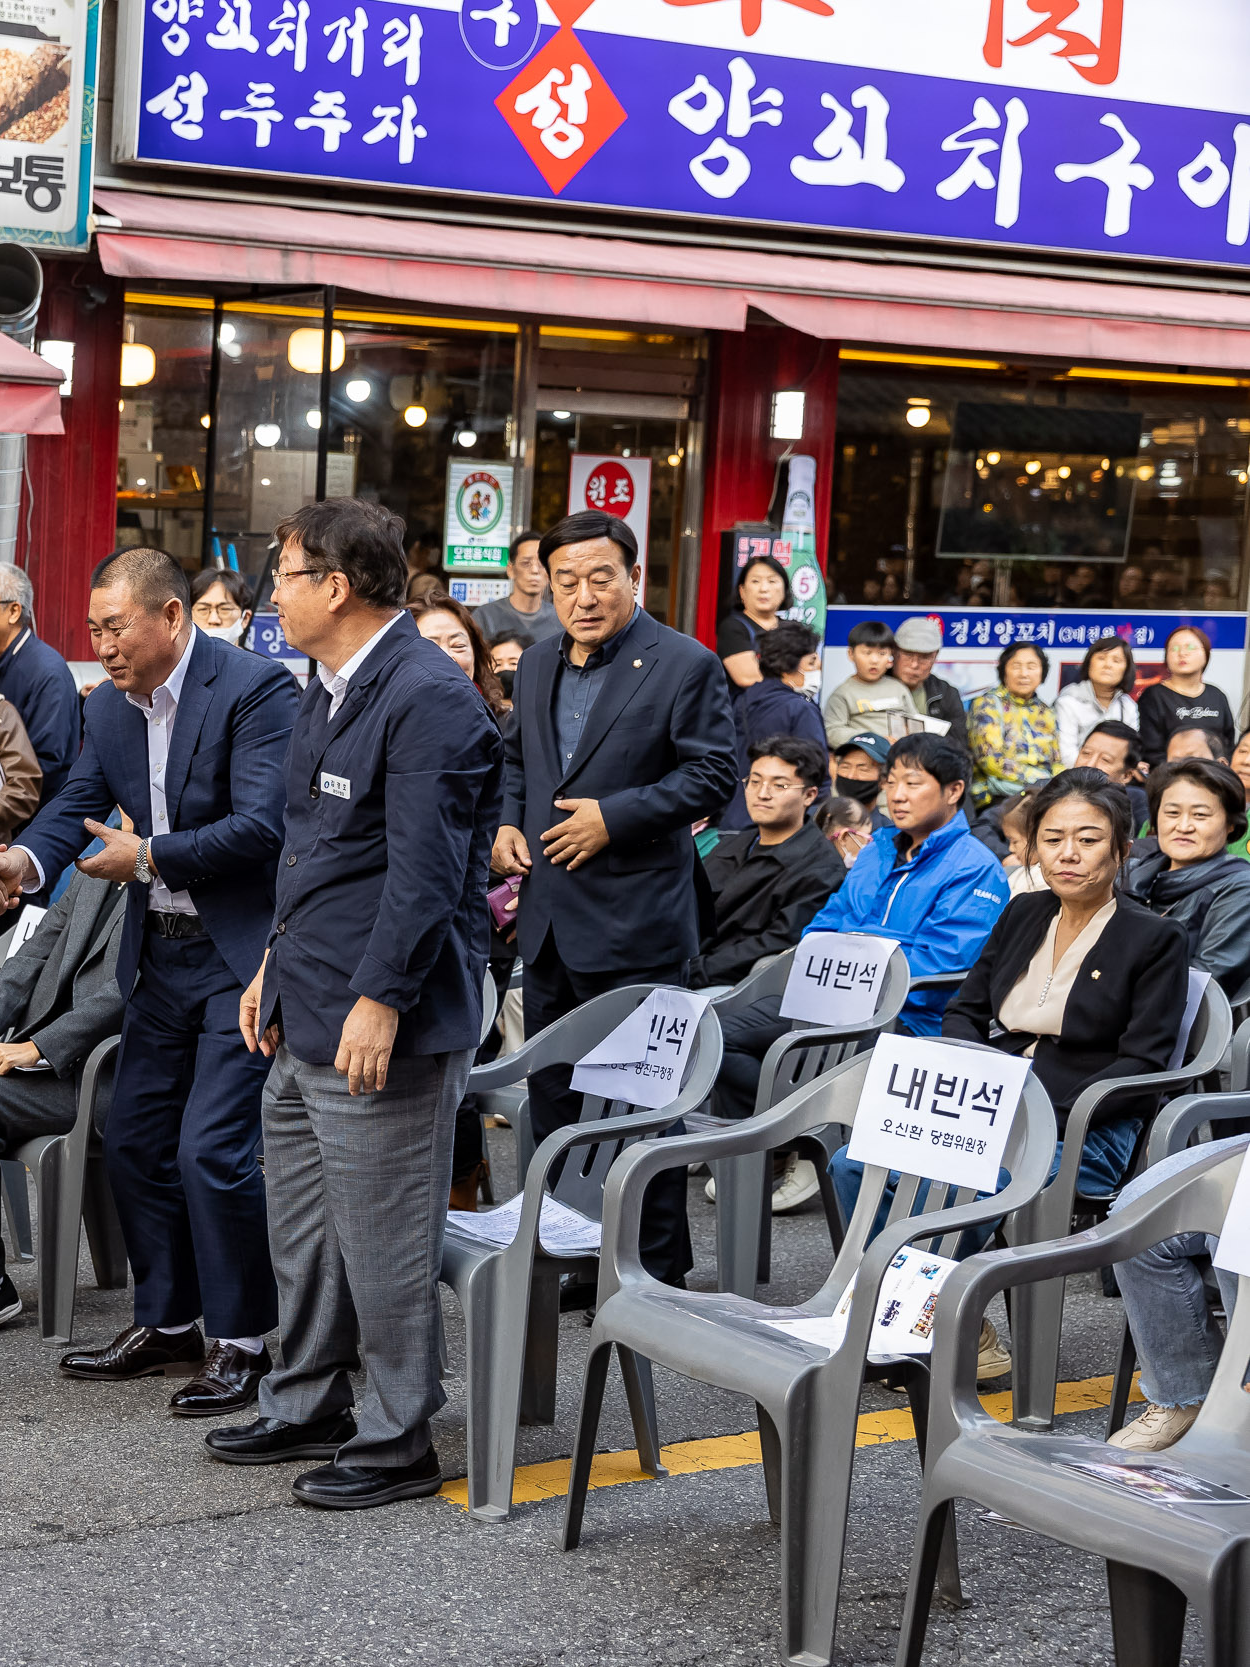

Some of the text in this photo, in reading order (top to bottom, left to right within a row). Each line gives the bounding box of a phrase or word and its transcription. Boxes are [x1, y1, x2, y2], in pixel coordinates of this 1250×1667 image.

[151, 0, 423, 87] 양꼬치거리
[145, 71, 427, 165] 선두주자
[668, 57, 1250, 246] 양꼬치구이
[587, 475, 631, 508] 원조
[453, 546, 502, 561] 모범음식점
[950, 619, 1056, 645] 경성양꼬치
[805, 955, 878, 993] 내빈석
[634, 1061, 674, 1081] 광진구청장
[886, 1063, 1004, 1127] 내빈석
[880, 1118, 987, 1156] 오신환 당협위원장
